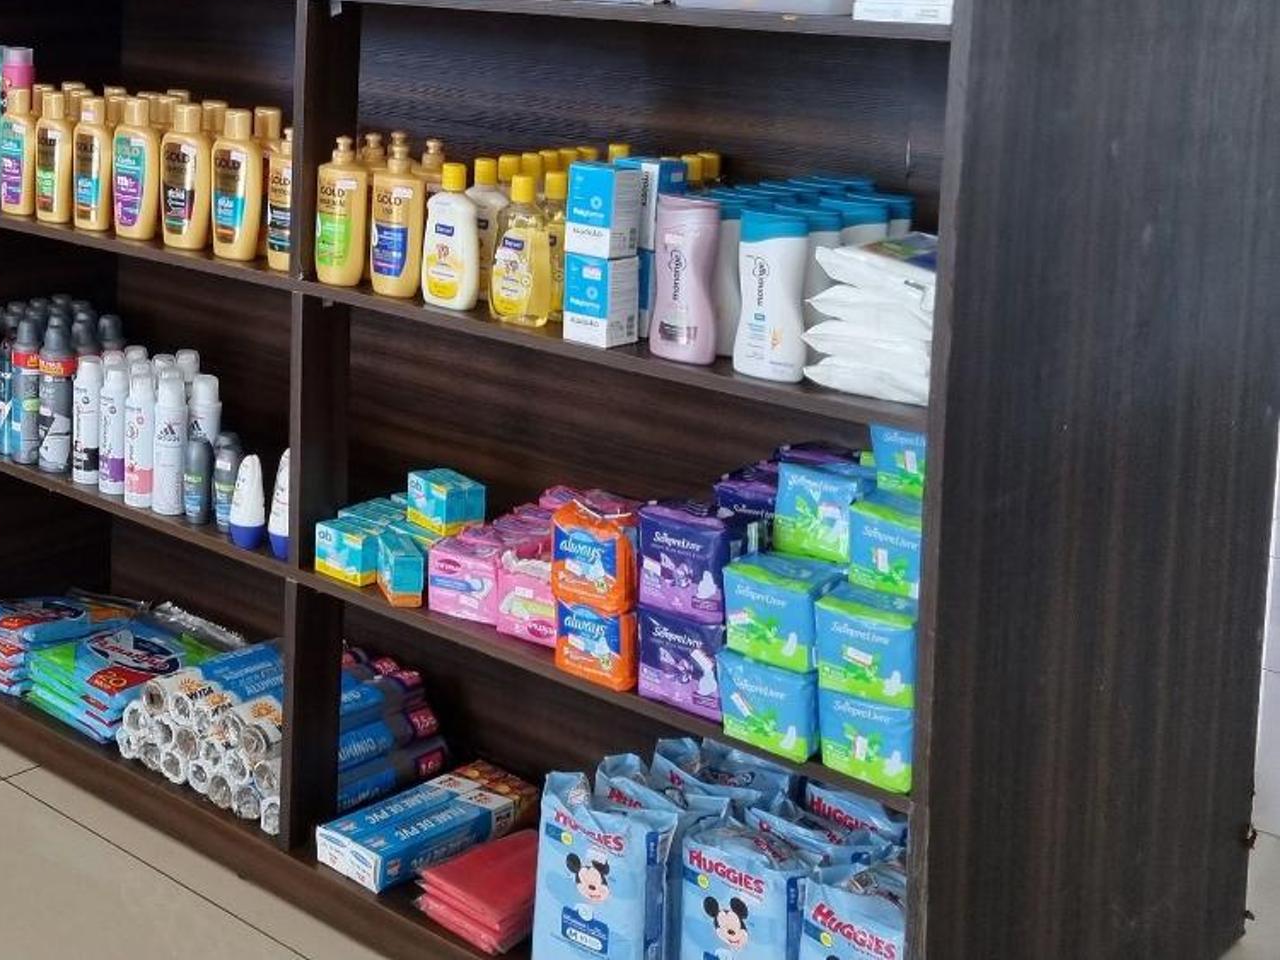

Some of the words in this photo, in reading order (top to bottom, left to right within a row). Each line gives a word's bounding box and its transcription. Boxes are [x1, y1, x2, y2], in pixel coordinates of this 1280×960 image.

[320, 186, 345, 198] GOLD
[377, 193, 402, 206] GOLD
[559, 538, 604, 561] always
[564, 614, 608, 637] always
[395, 825, 420, 841] PVC
[687, 849, 766, 895] HUGGIES
[811, 902, 897, 960] HUGGIES
